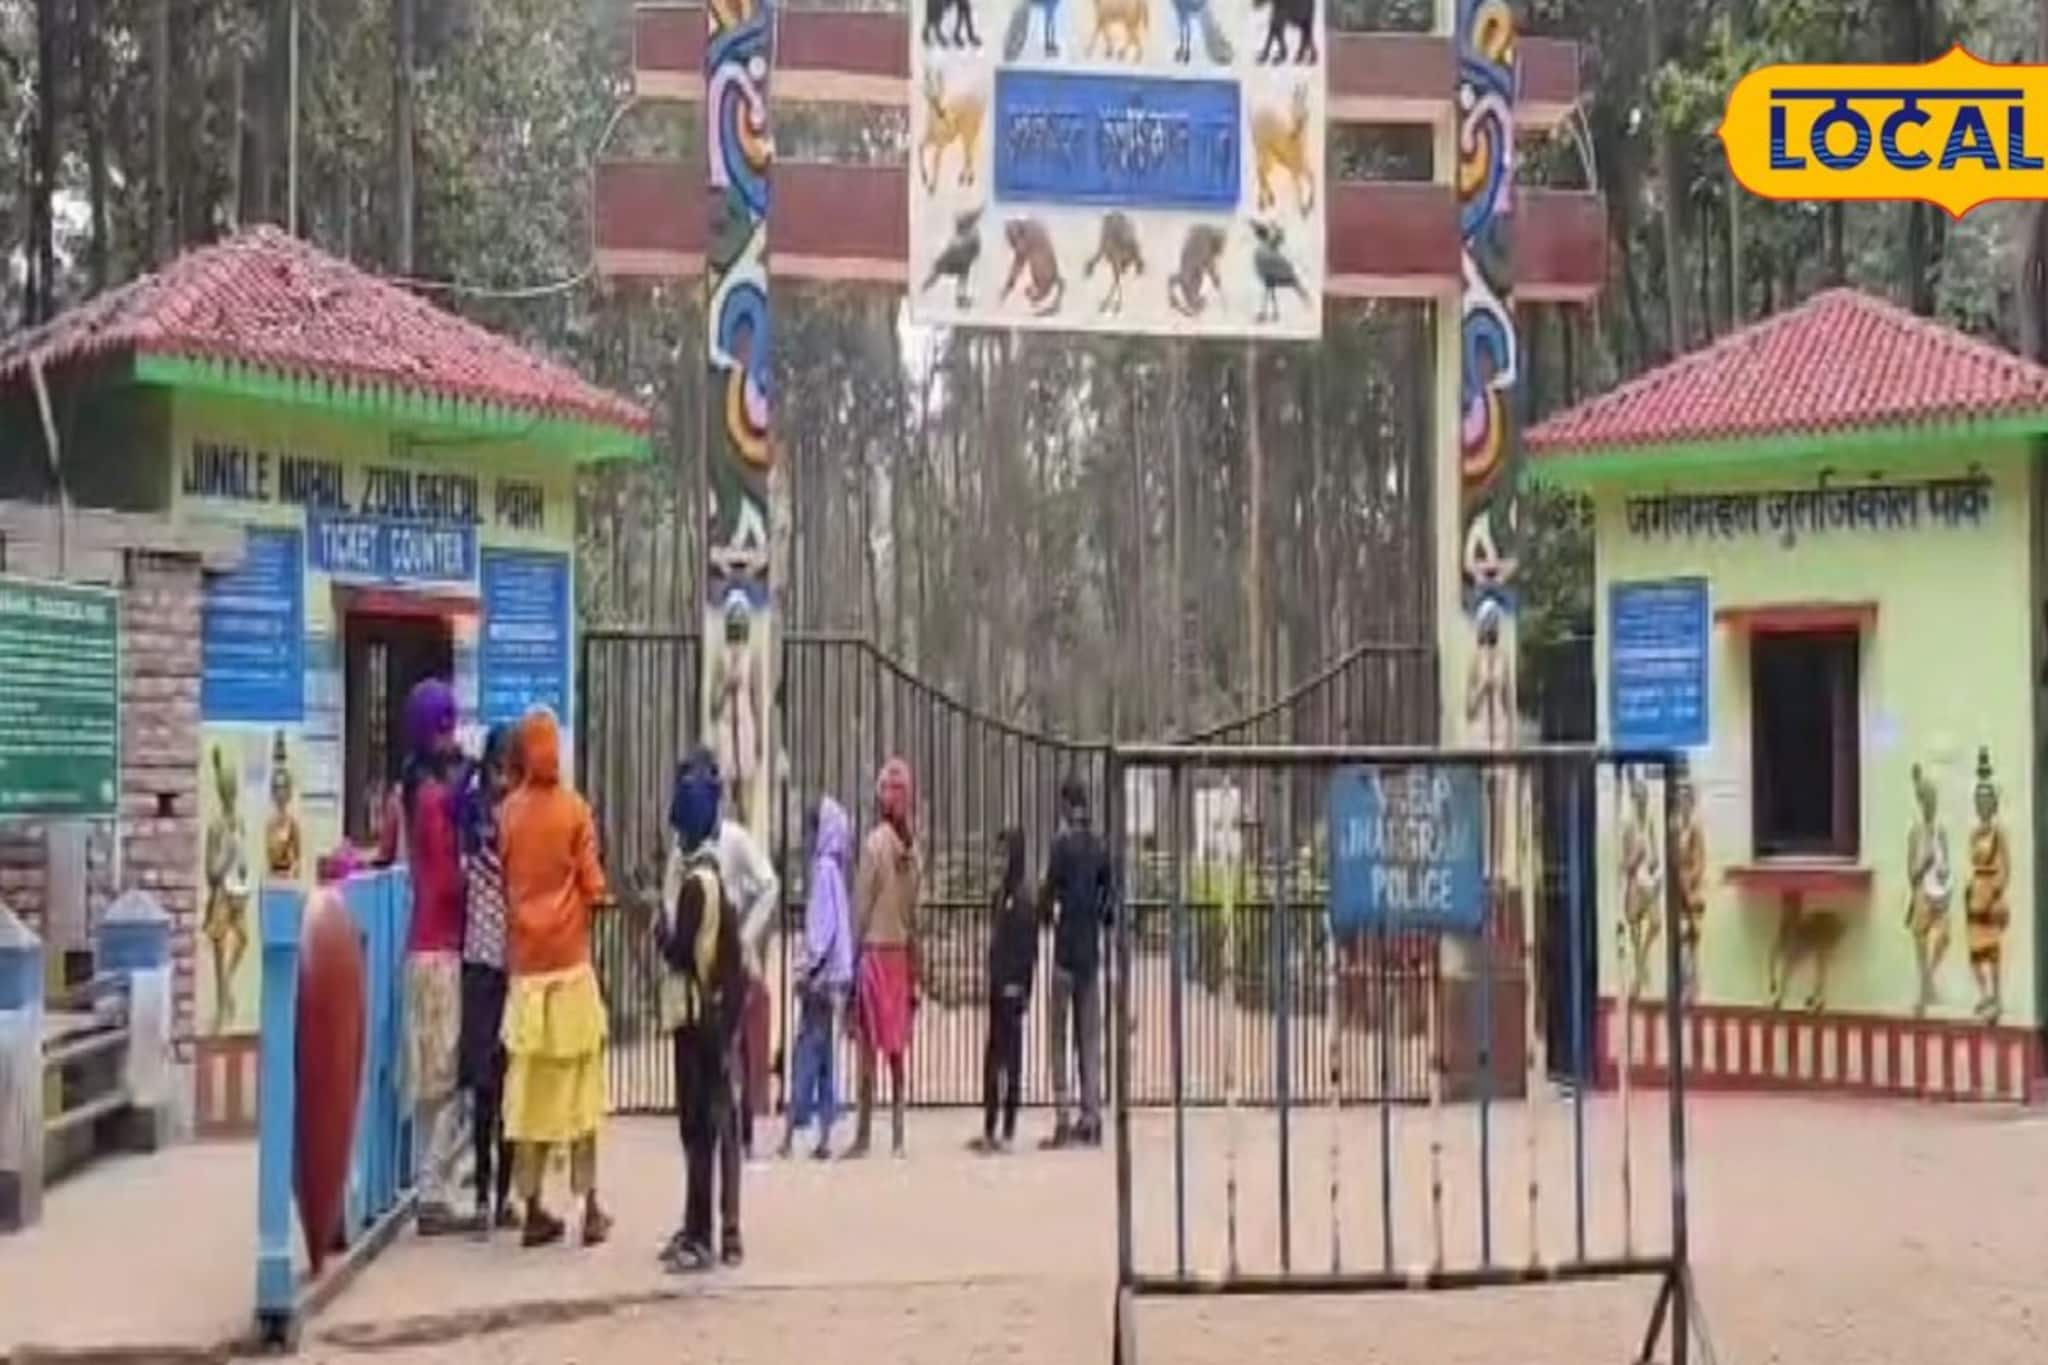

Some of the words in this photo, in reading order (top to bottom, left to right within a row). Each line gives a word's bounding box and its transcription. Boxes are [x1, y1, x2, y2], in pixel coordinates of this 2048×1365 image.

[181, 440, 269, 503] JUNGLE
[359, 465, 485, 524] ZOOLOGICAL
[495, 478, 543, 531] PARK
[321, 523, 378, 569] TICKET
[391, 527, 464, 574] COUNTER
[1371, 863, 1453, 911] POLICE
